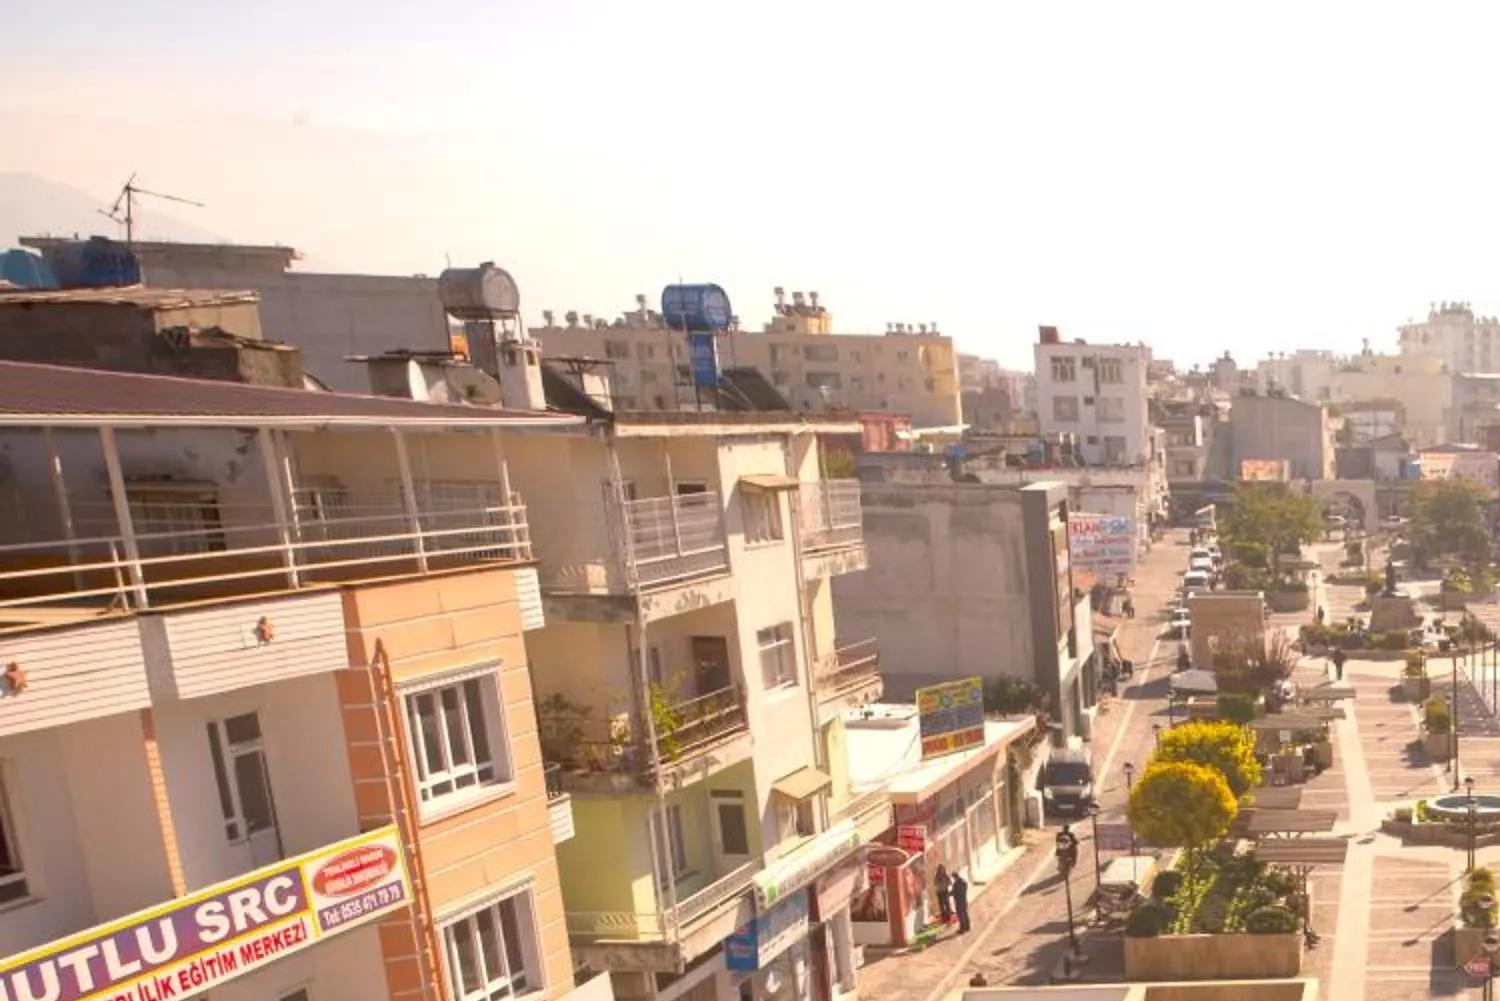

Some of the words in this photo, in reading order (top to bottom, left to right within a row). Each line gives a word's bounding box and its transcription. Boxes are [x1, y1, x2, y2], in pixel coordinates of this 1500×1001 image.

[195, 877, 298, 943] SRC
[178, 951, 238, 992] EĞİTİM
[239, 917, 308, 967] MERKEZİ
